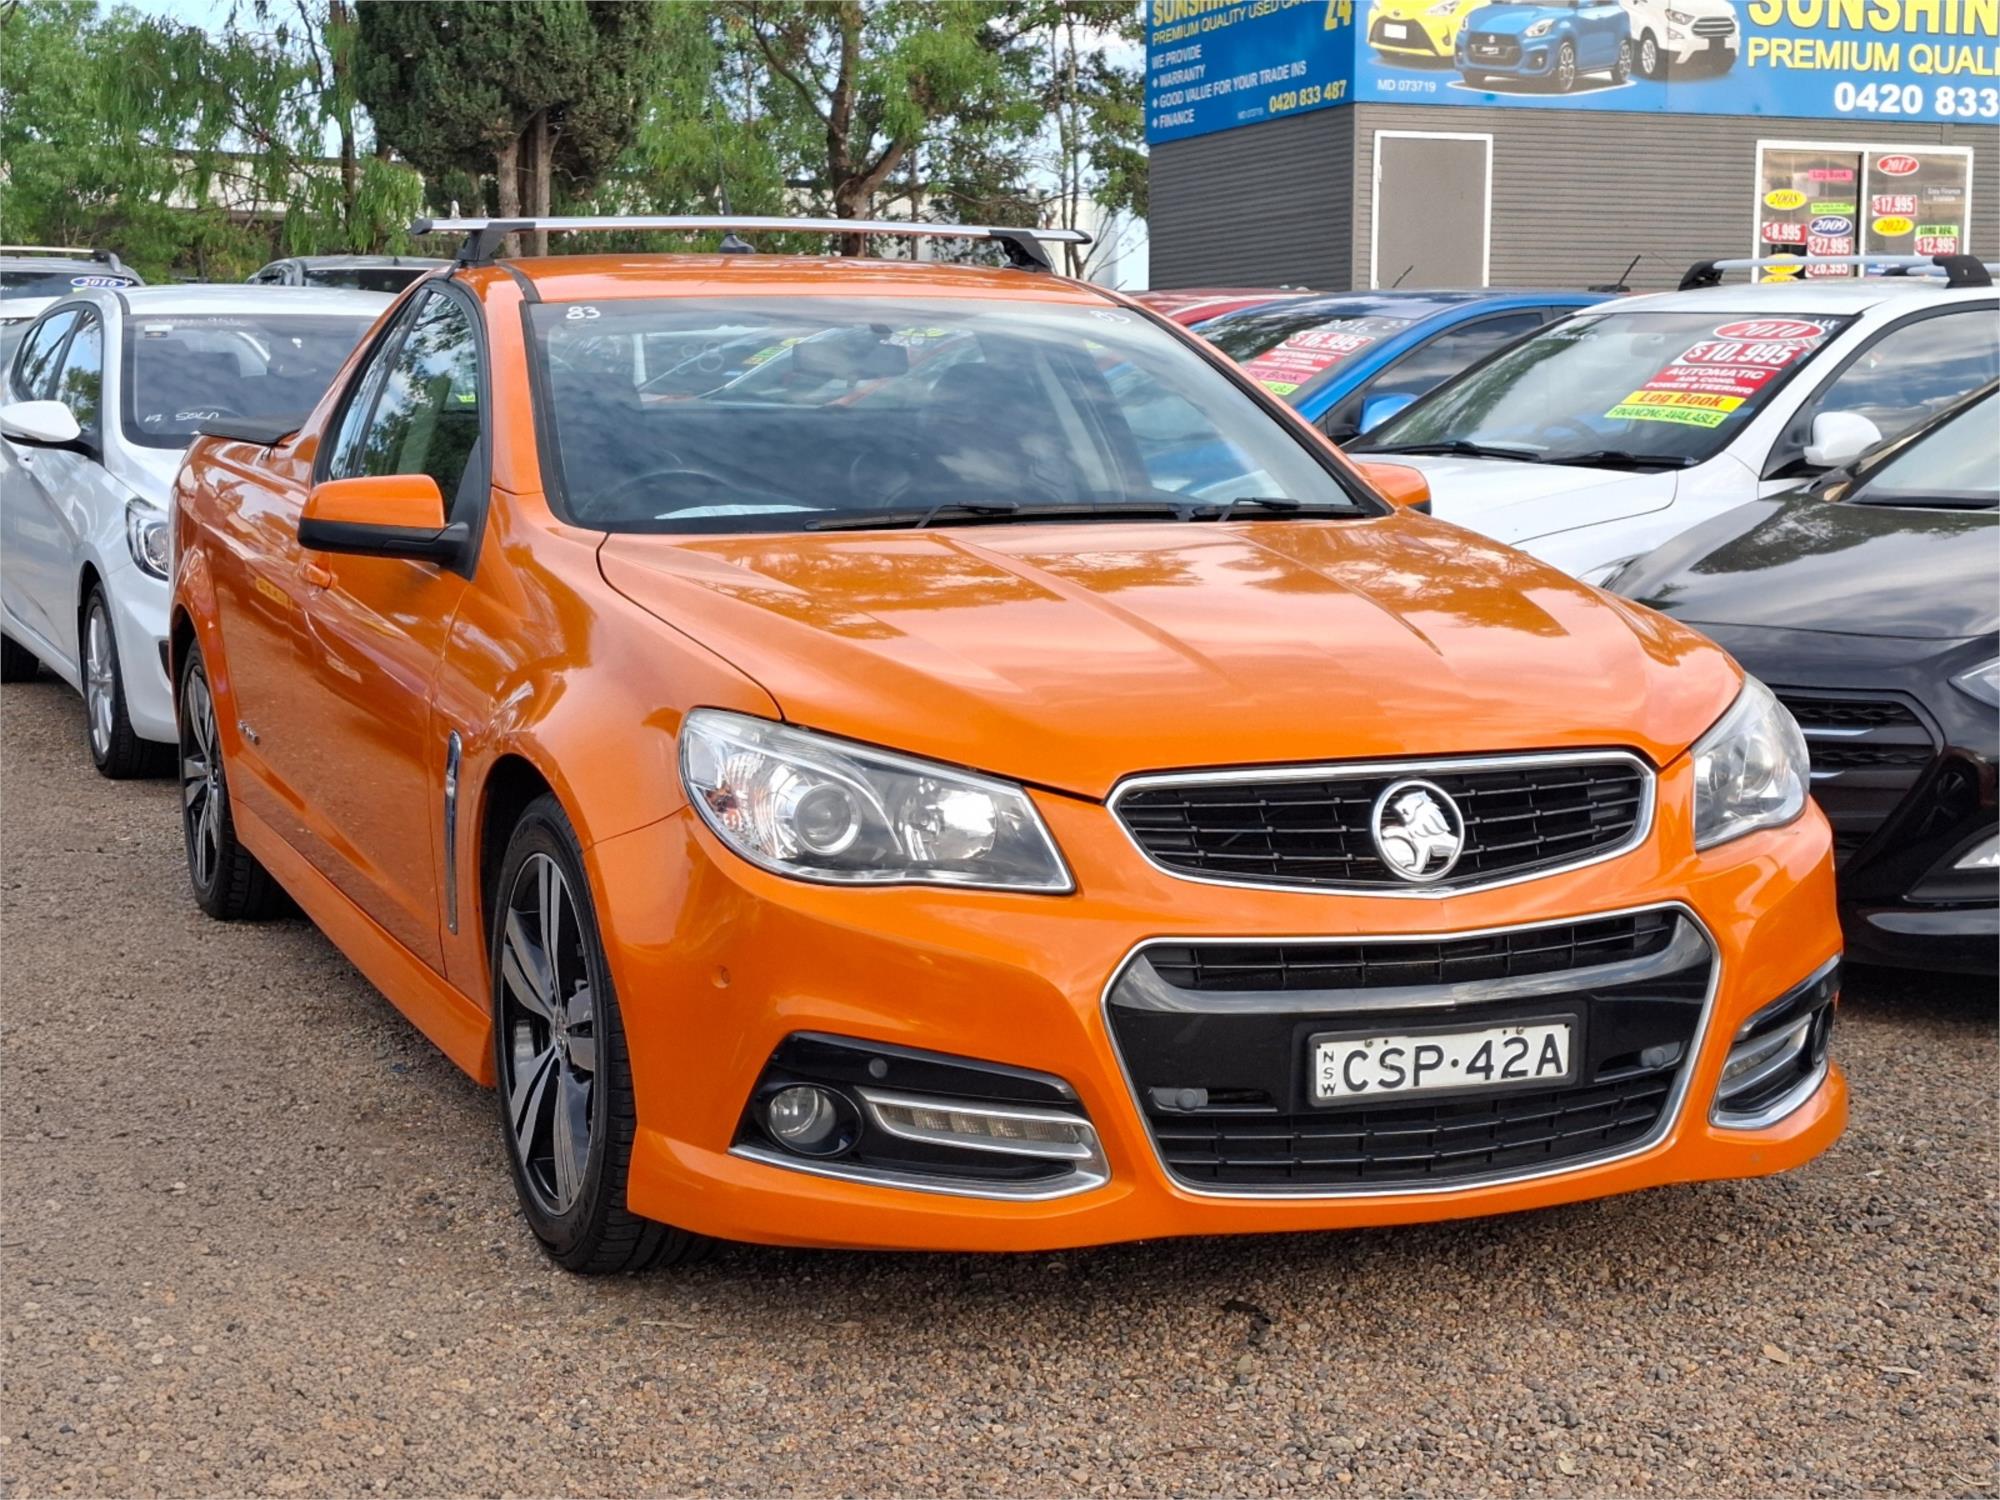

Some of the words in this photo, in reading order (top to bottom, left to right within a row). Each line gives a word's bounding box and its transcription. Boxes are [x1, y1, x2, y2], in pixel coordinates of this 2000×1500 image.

[1152, 20, 1199, 46] PREMIUM
[1201, 7, 1247, 32] QUALITY
[1248, 0, 1279, 18] USED
[1152, 54, 1164, 70] WE
[1165, 44, 1202, 66] PROVIDE
[1747, 37, 1899, 72] PREMIUM
[1160, 64, 1206, 88] WARRANTY
[1160, 90, 1184, 108] GOOD
[1185, 83, 1212, 103] VALUE
[1213, 79, 1231, 96] FOR
[1233, 72, 1258, 92] YOUR
[1259, 64, 1289, 85] TRADE
[1291, 60, 1307, 78] INS
[1377, 79, 1396, 91] MD
[1398, 80, 1436, 93] 073719
[1269, 91, 1297, 113] 0420
[1299, 85, 1321, 106] 833
[1324, 80, 1347, 99] 487
[1834, 82, 1923, 115] 0420
[1935, 86, 1999, 117] 833
[1160, 108, 1195, 128] FINANCE
[1814, 220, 1846, 231] 2009
[1809, 237, 1850, 254] $27,995
[1916, 236, 1956, 253] $12,995
[566, 306, 601, 320] 83
[1727, 322, 1811, 338] 2010
[1688, 343, 1800, 365] $10,995
[1666, 367, 1766, 380] AUTOMATIC
[1645, 381, 1690, 390] POWER
[1692, 382, 1756, 394] STEERING
[1638, 392, 1671, 405] Log
[1675, 393, 1725, 407] Book
[1609, 406, 1662, 418] FINANCING
[1665, 409, 1722, 426] AVAILABLE
